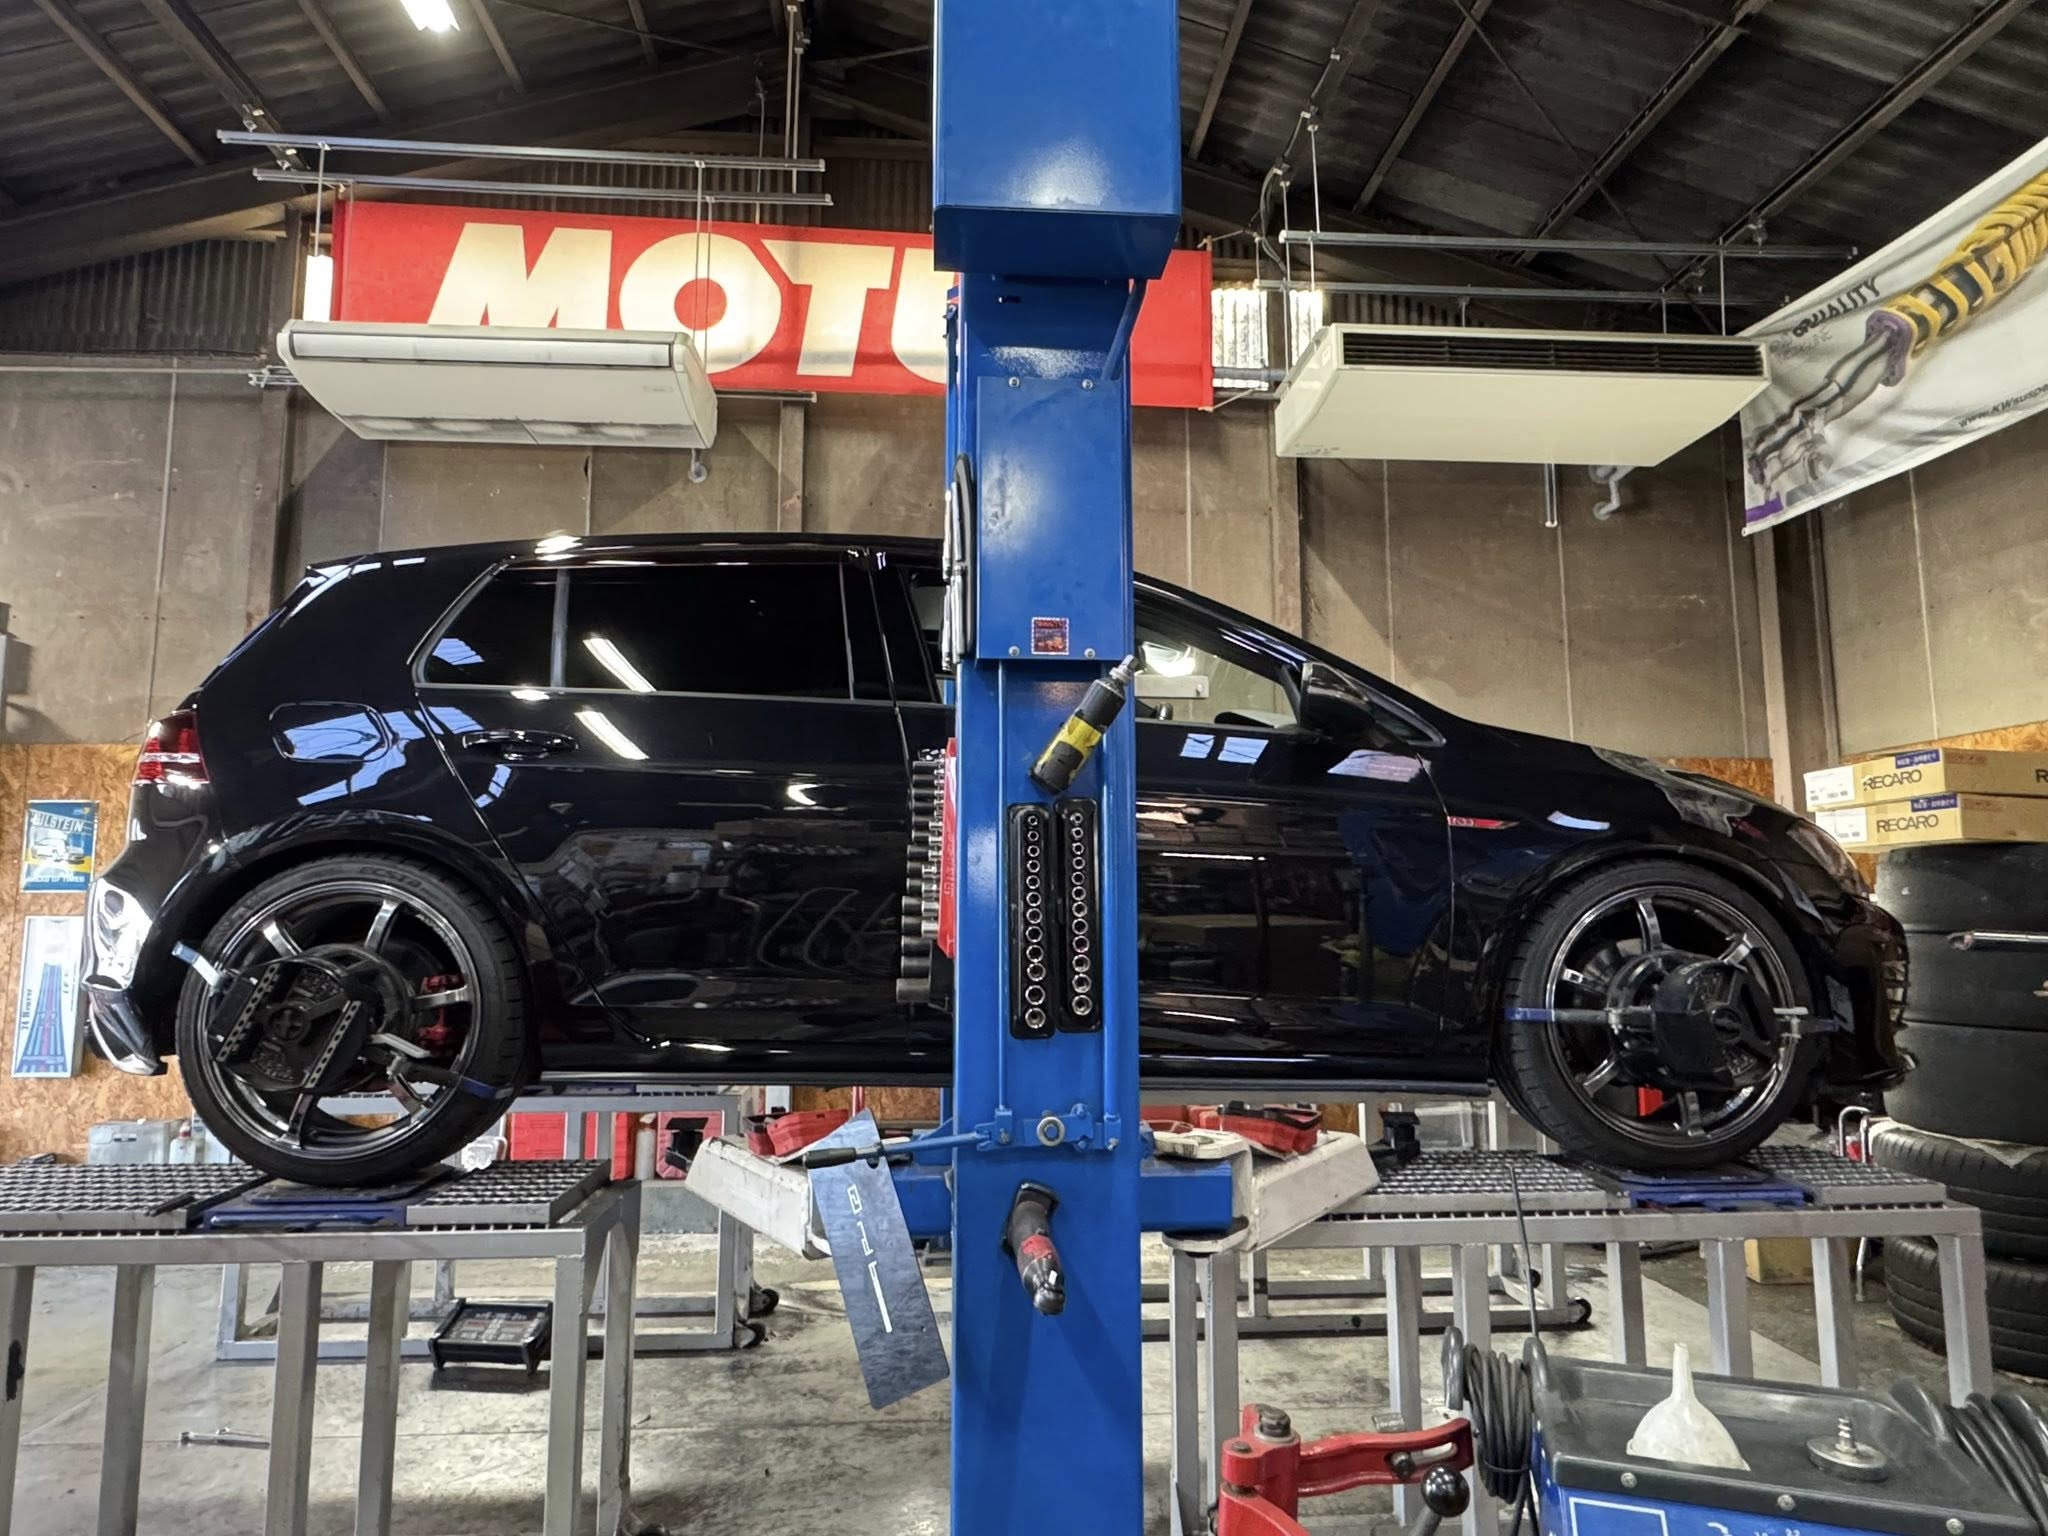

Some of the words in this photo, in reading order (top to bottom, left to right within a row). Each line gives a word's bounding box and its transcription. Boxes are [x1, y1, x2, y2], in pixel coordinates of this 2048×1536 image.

[428, 222, 956, 385] MOTU
[1863, 769, 1922, 791] RECARO
[1876, 814, 1938, 833] RECARO
